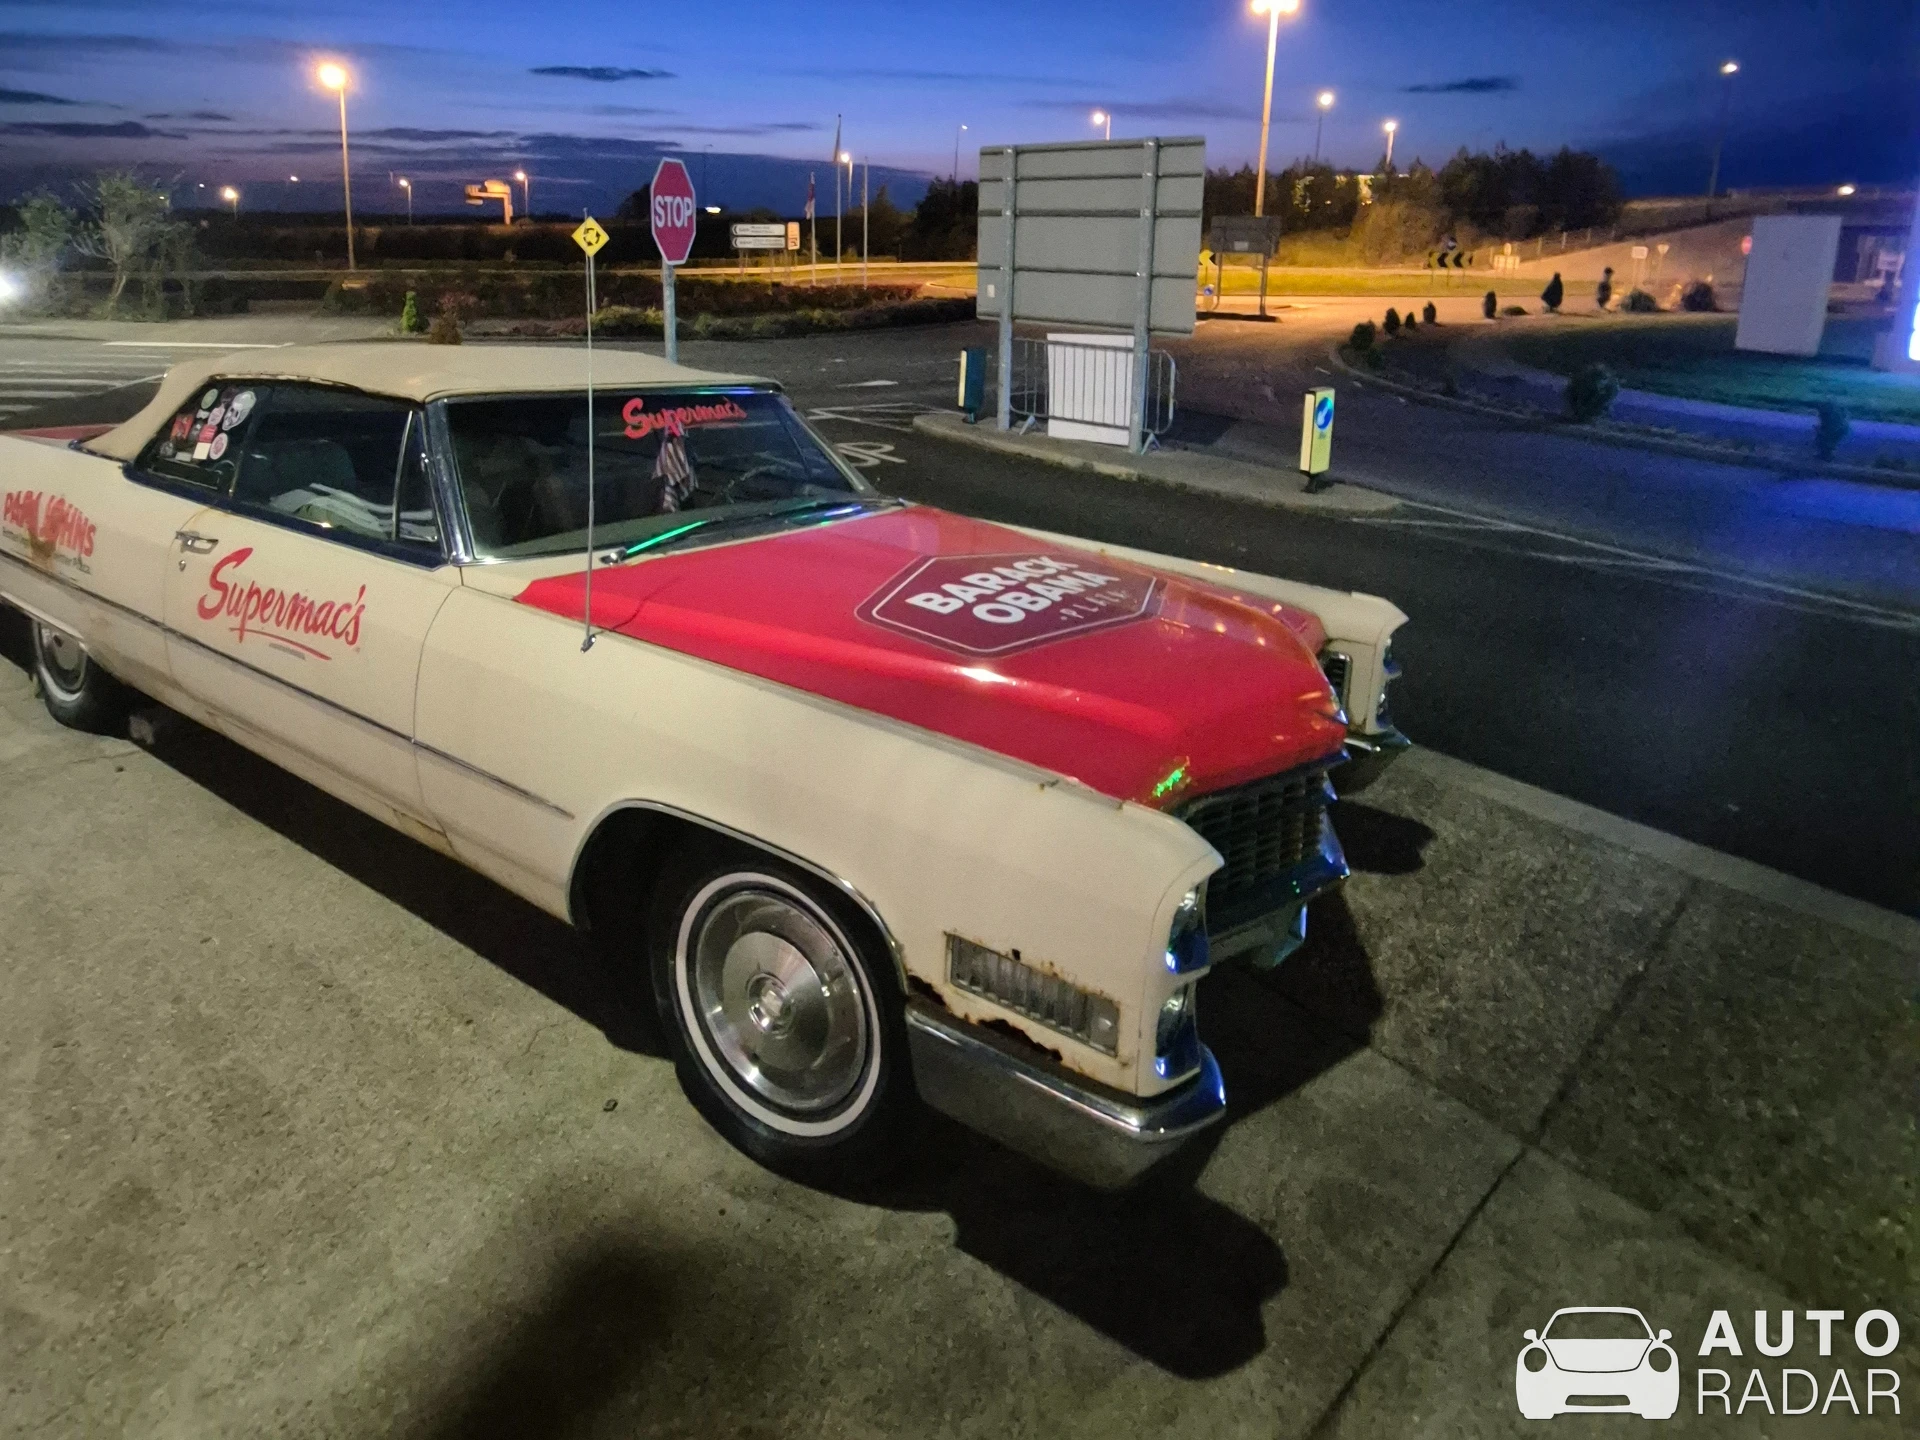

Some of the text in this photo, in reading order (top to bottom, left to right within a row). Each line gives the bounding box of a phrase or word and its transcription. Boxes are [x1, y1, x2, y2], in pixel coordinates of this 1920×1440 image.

[654, 195, 694, 228] STOP
[196, 547, 366, 646] Supermac's
[905, 556, 1079, 615] BARACK
[972, 570, 1120, 624] OBAMA
